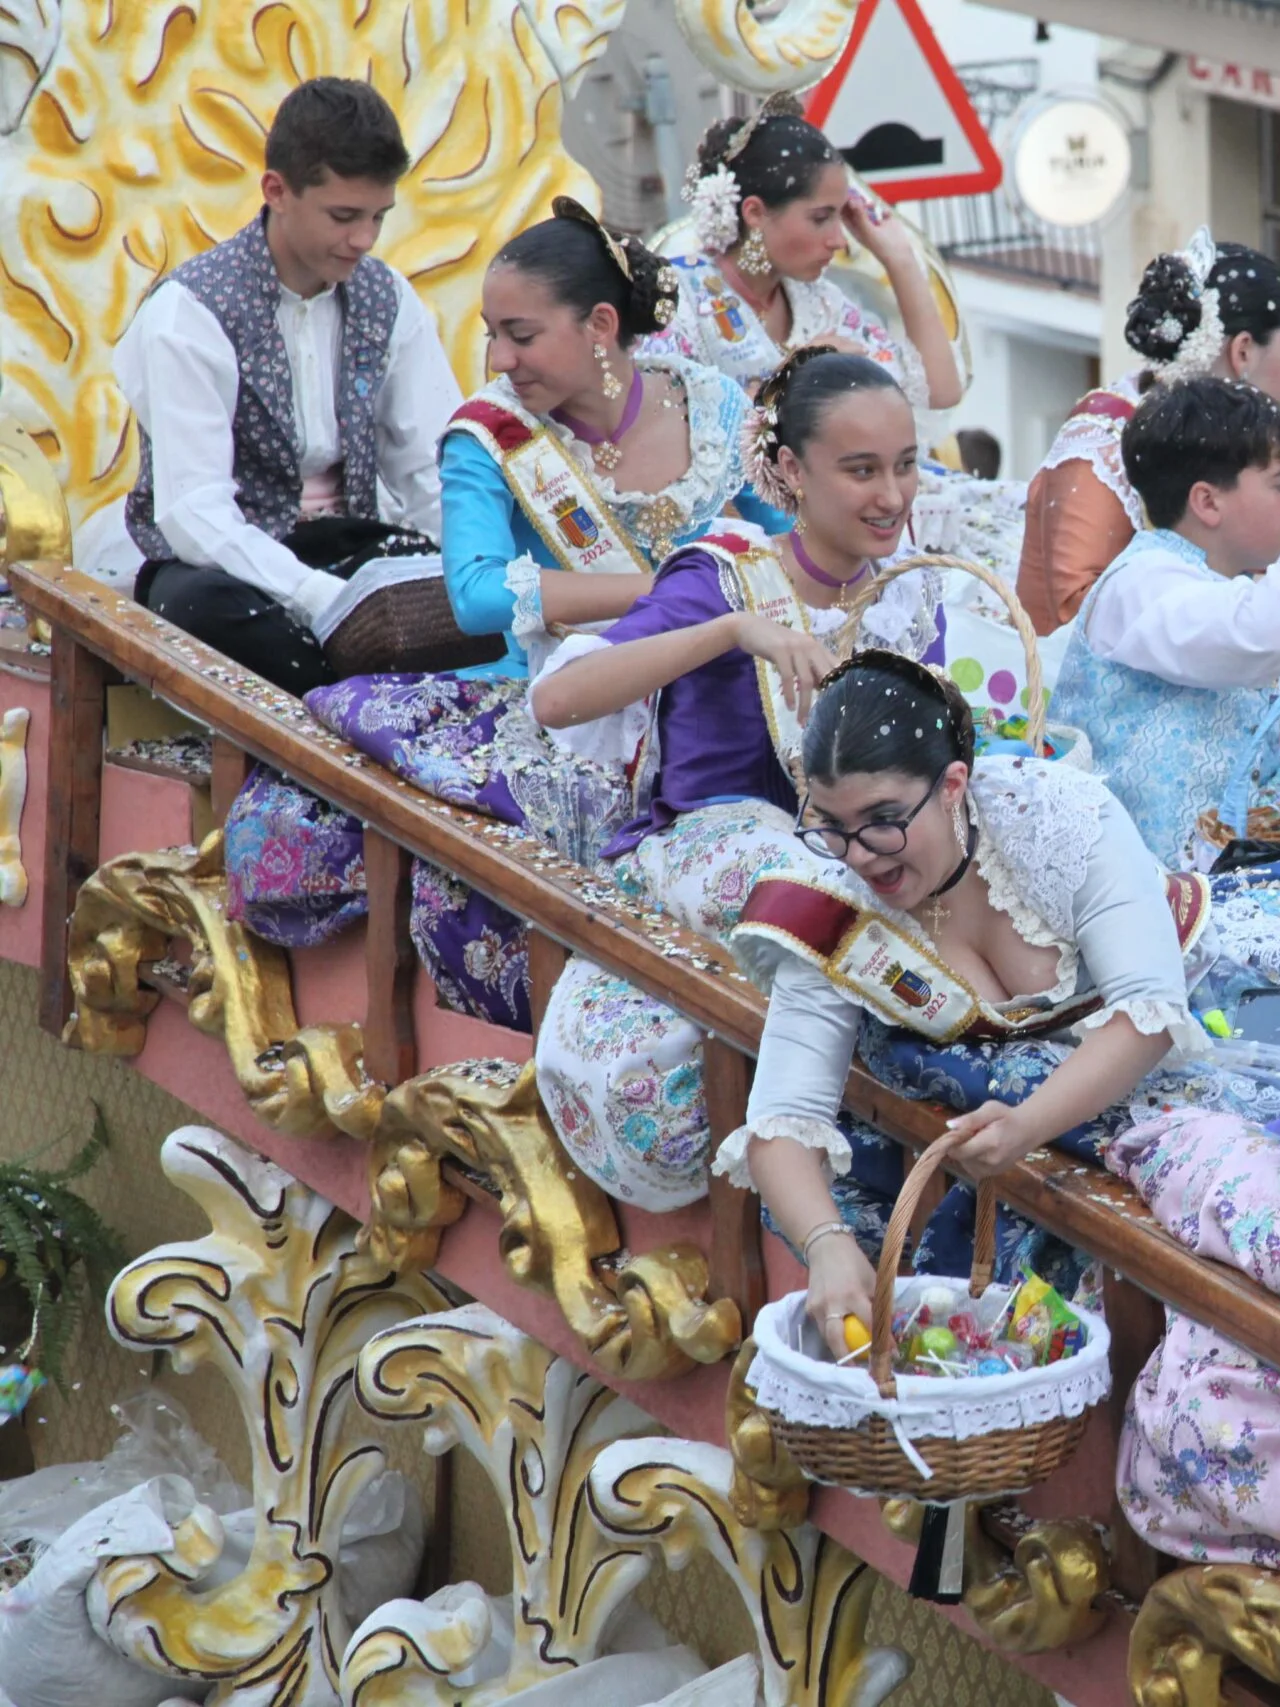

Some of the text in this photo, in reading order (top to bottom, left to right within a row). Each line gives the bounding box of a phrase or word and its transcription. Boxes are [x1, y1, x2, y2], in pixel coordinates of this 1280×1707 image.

[579, 539, 613, 565] 2023
[859, 942, 889, 977] FOGUERES
[921, 992, 948, 1021] 2023
